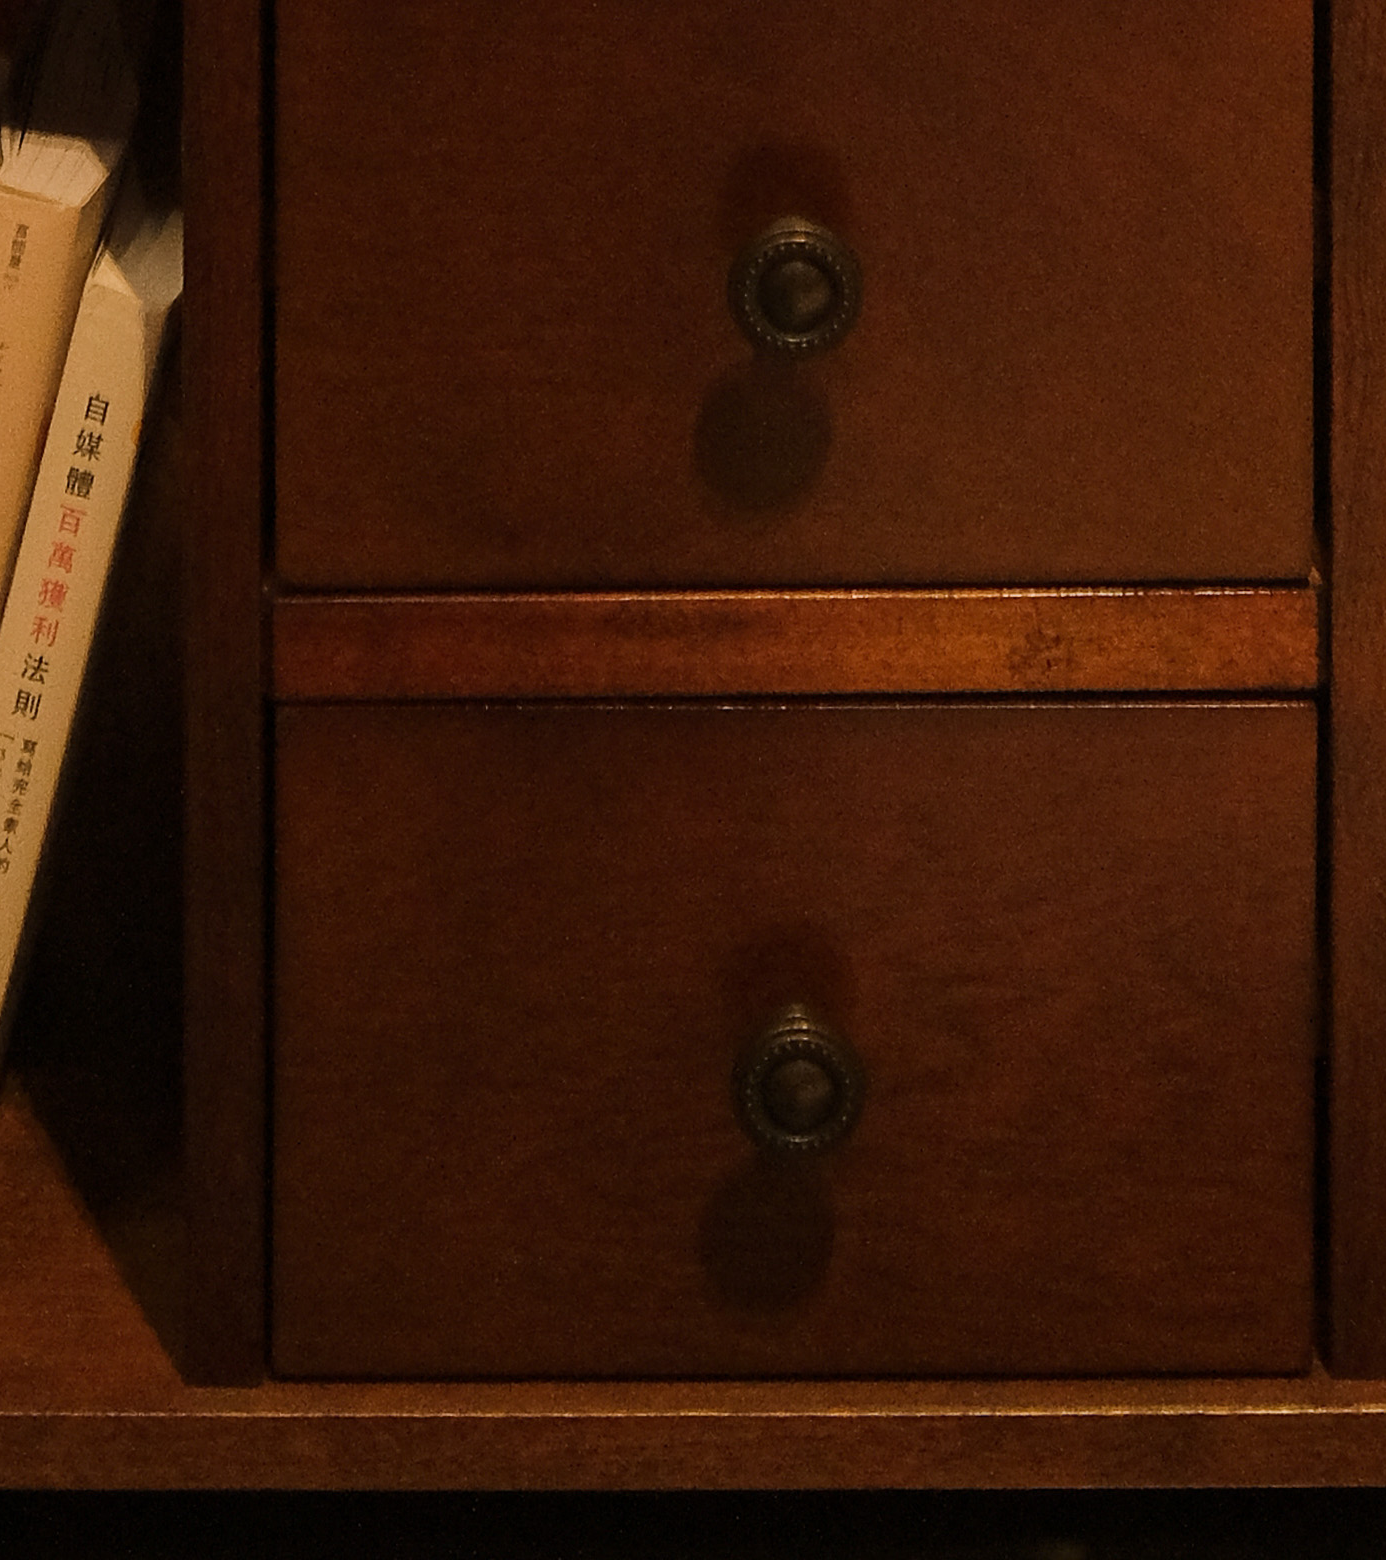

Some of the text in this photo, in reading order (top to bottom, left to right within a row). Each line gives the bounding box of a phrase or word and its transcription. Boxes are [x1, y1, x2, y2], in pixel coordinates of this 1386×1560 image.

[9, 392, 111, 722] 自媒體百萬獲利法則
